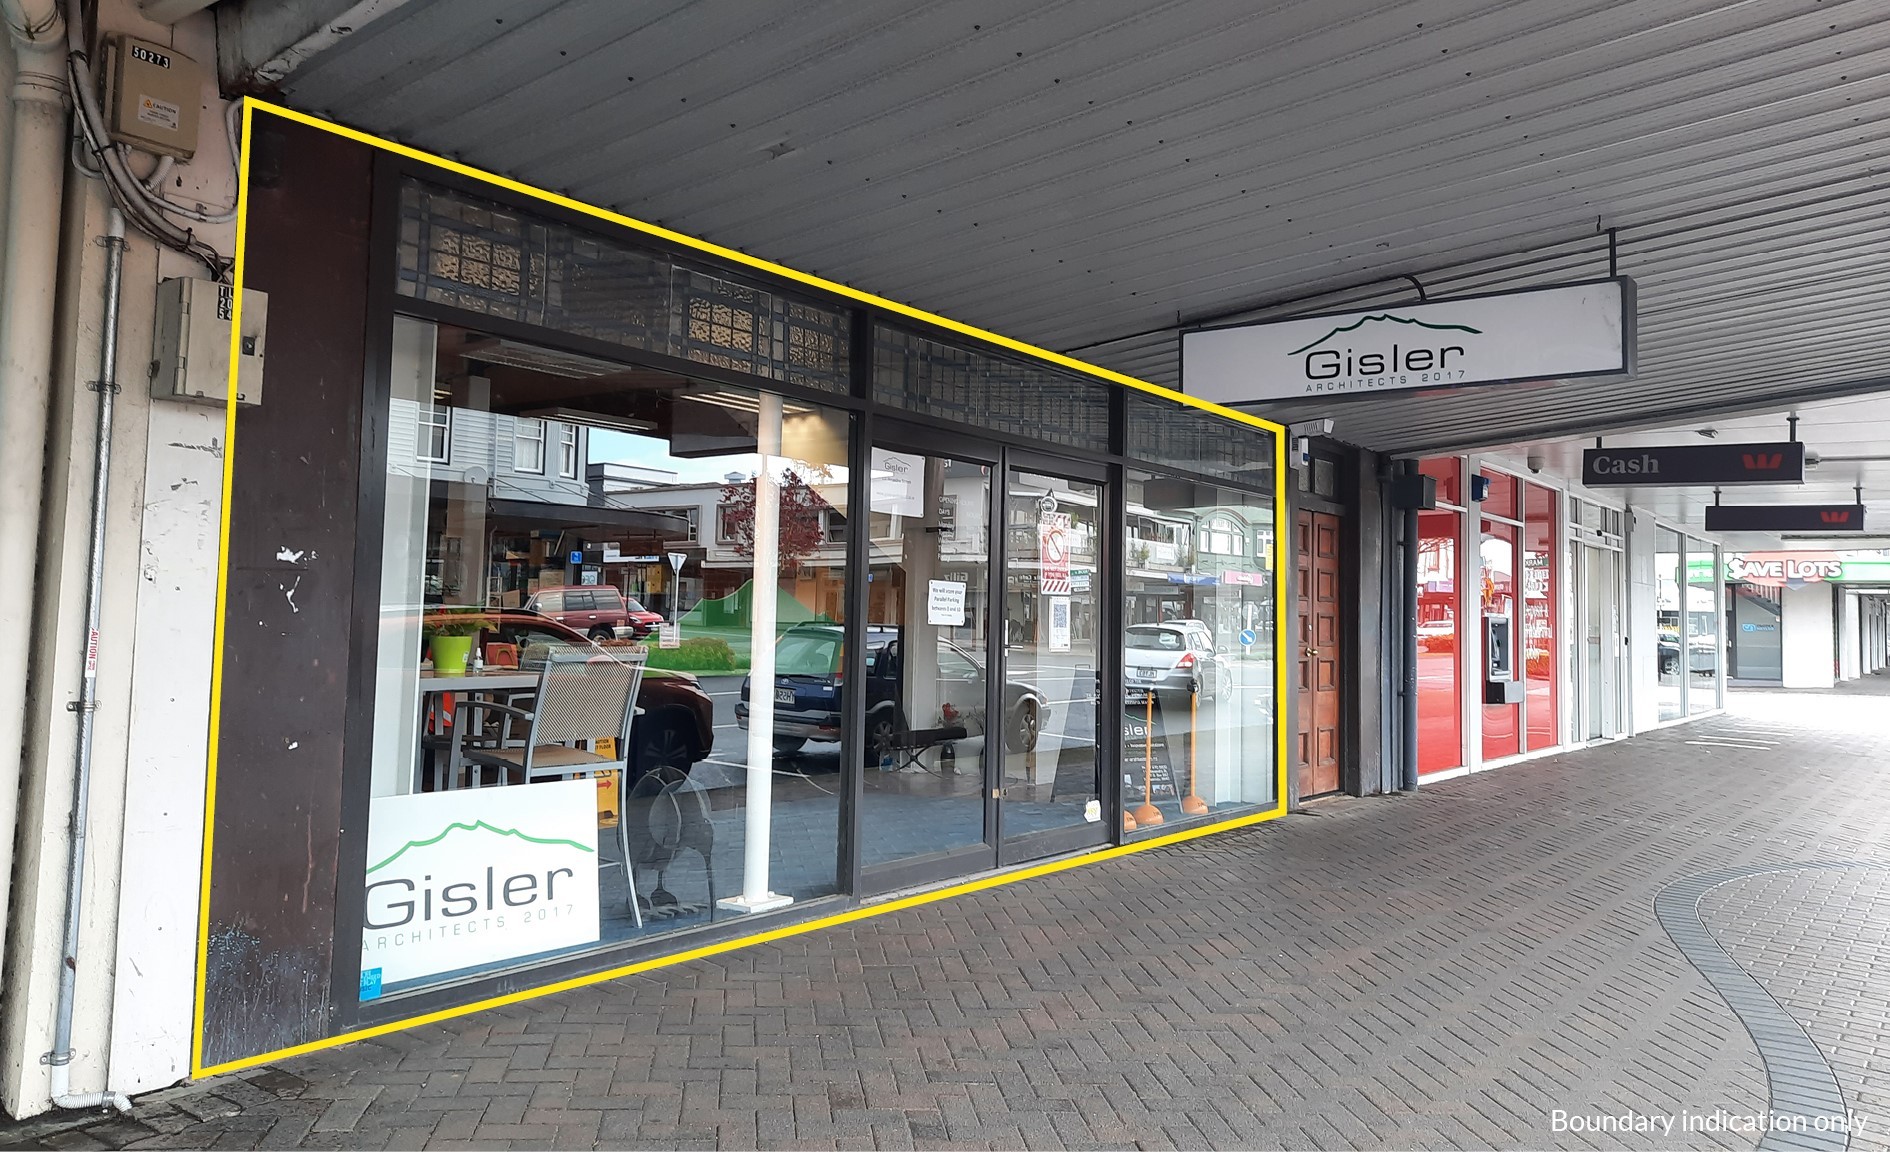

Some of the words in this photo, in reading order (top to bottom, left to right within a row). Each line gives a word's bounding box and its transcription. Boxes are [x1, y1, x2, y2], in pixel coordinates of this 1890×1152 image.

[133, 47, 169, 68] 50273
[153, 103, 176, 114] CAUTION
[1305, 344, 1465, 380] Gisler
[1306, 375, 1407, 392] ARCHITECTS
[1421, 370, 1465, 382] 2017
[1592, 454, 1660, 475] Cash
[1785, 559, 1843, 579] LOTS
[363, 866, 574, 930] Gisler
[523, 904, 574, 924] 2017
